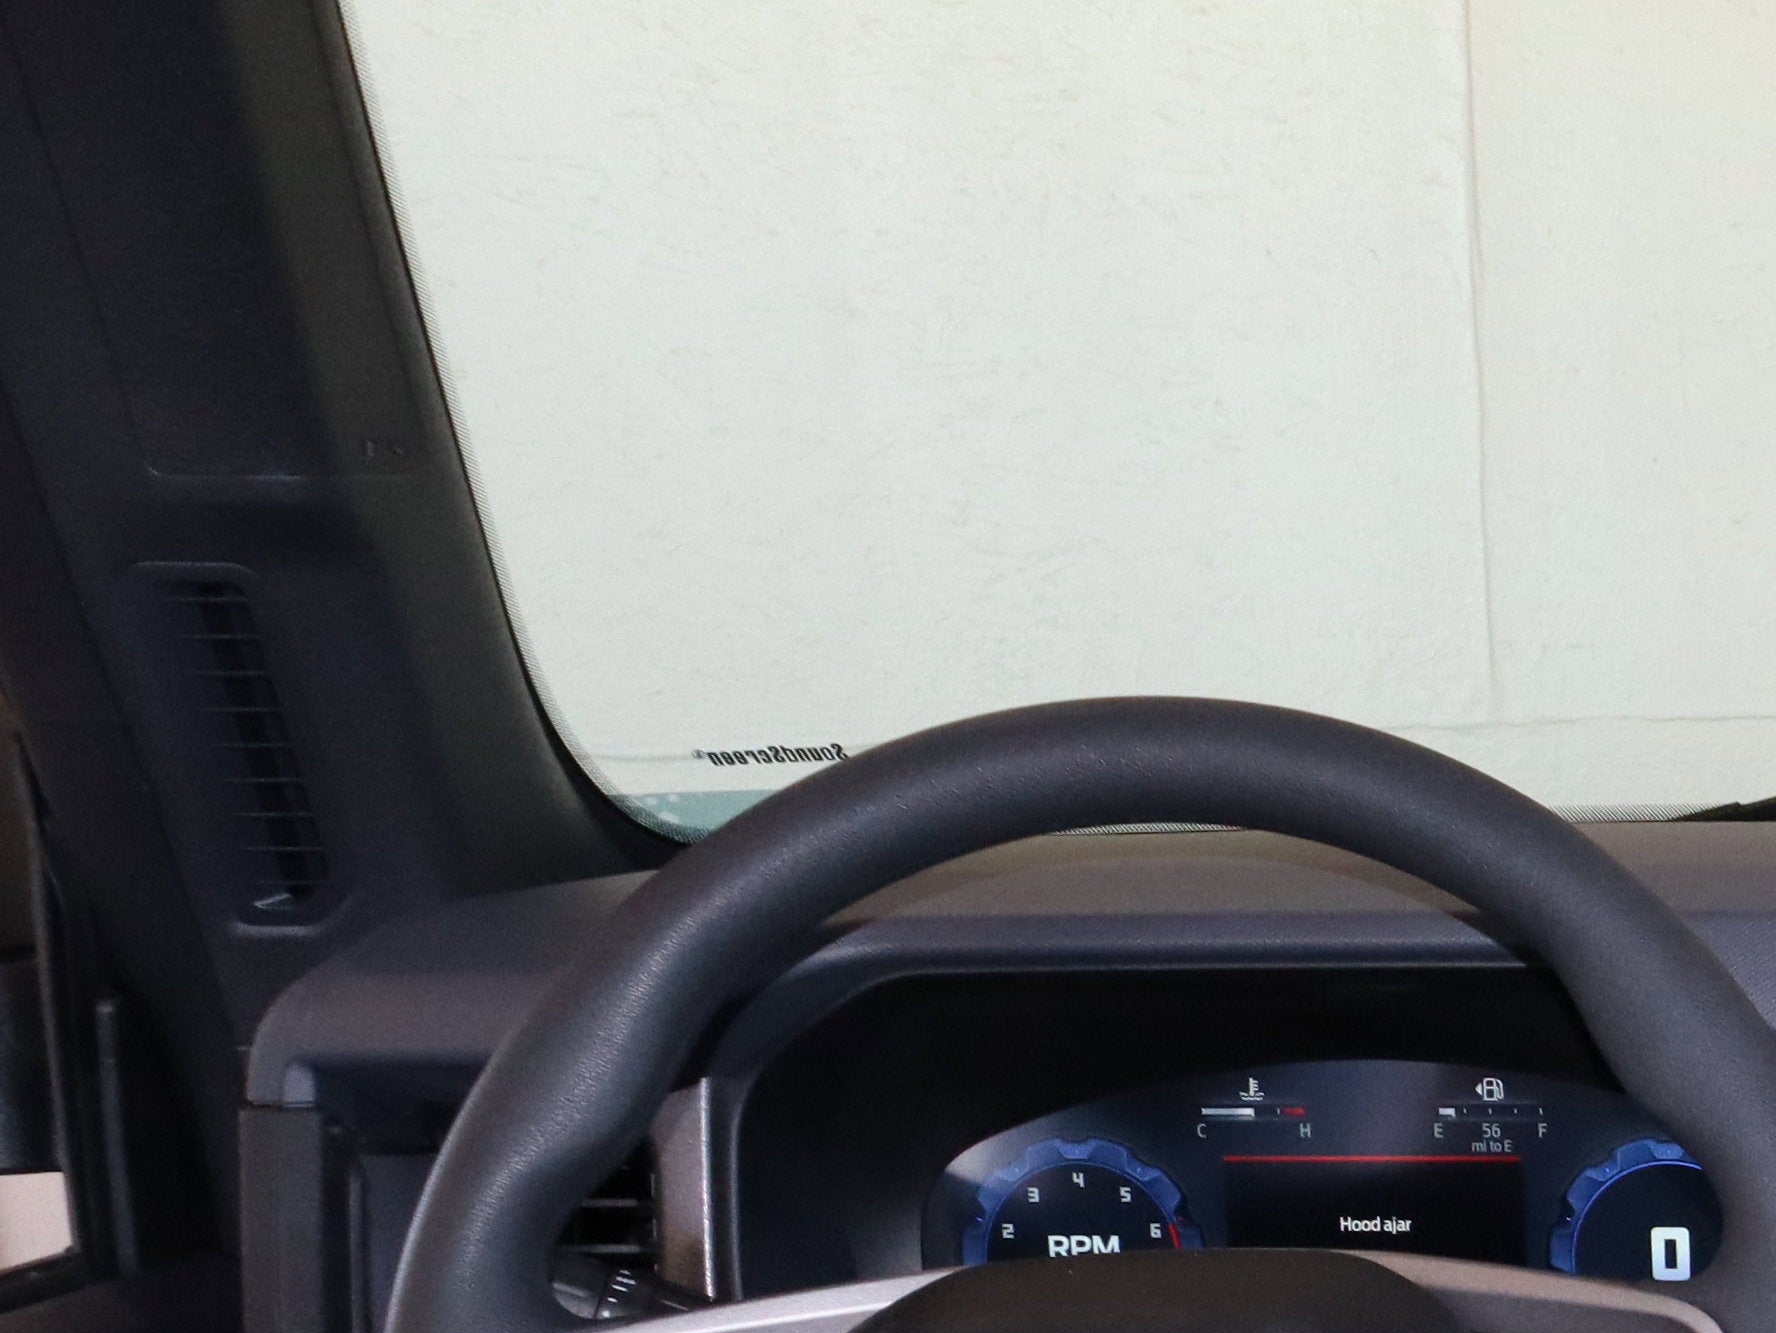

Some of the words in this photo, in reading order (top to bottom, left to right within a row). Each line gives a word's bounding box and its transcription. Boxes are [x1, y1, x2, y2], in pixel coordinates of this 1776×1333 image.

[1197, 1124, 1207, 1138] C
[1300, 1124, 1311, 1138] H
[1434, 1124, 1443, 1138] E
[1482, 1123, 1501, 1138] 56
[1538, 1124, 1548, 1138] F
[1072, 1172, 1085, 1187] 4
[1027, 1187, 1039, 1202] 3
[1120, 1187, 1132, 1202] 5
[1002, 1224, 1015, 1238] 2
[1150, 1223, 1162, 1238] 6
[1340, 1216, 1380, 1231] Hood
[1383, 1217, 1411, 1235] ajar
[1048, 1235, 1120, 1257] RPM
